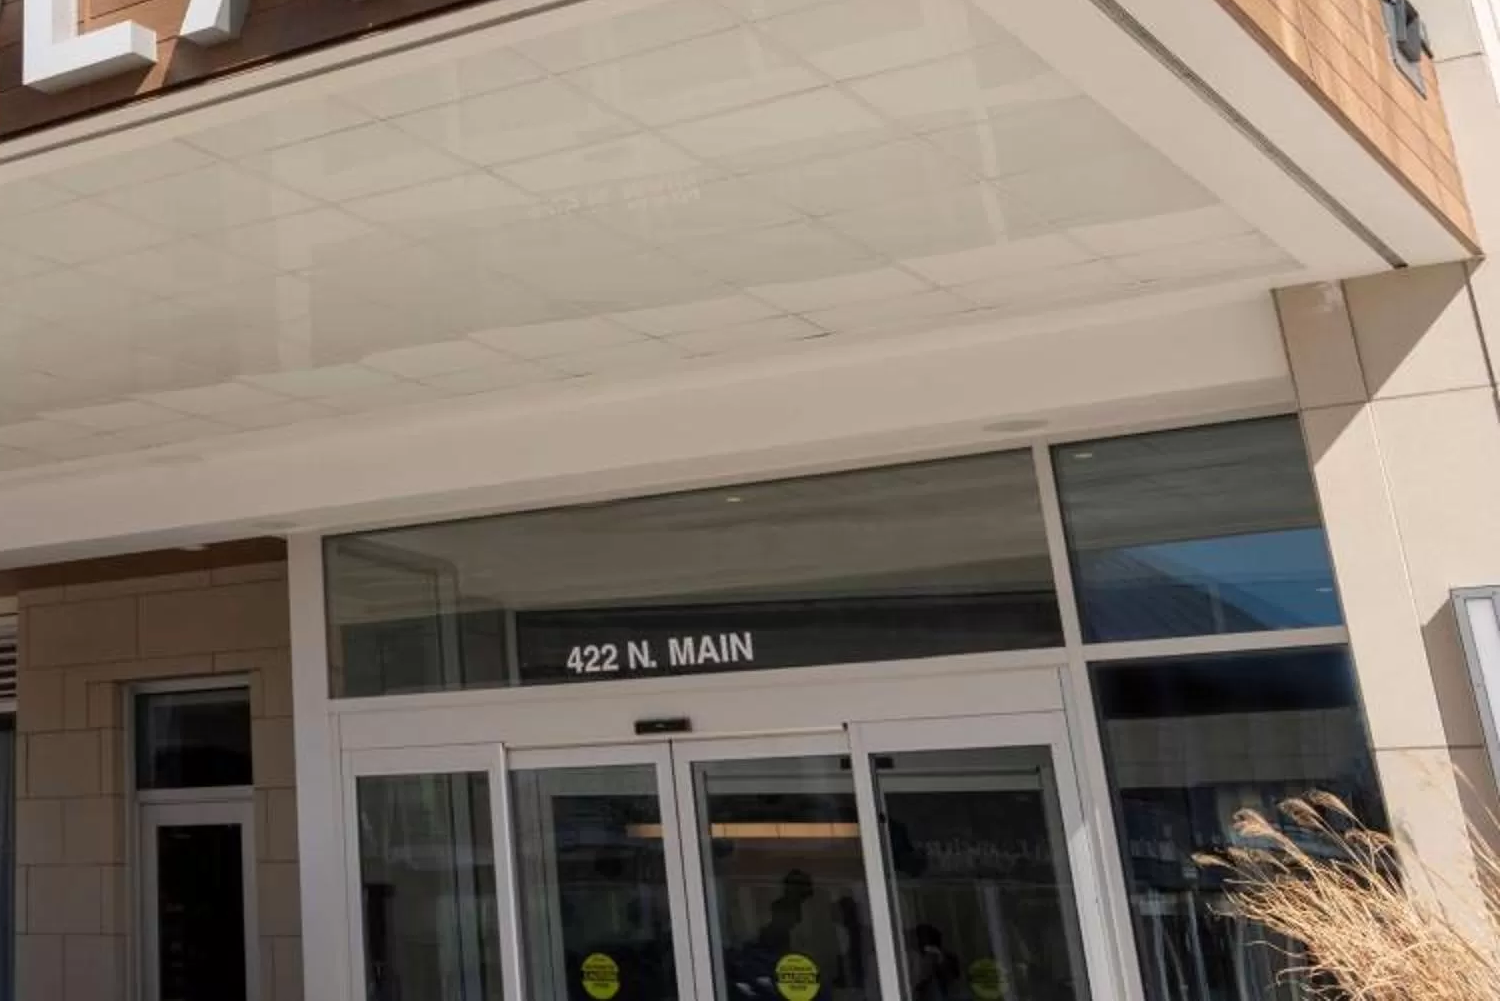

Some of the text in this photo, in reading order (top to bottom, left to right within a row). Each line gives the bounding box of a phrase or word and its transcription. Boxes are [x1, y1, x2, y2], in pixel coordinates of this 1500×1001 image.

[567, 631, 754, 674] 422 N. MAIN
